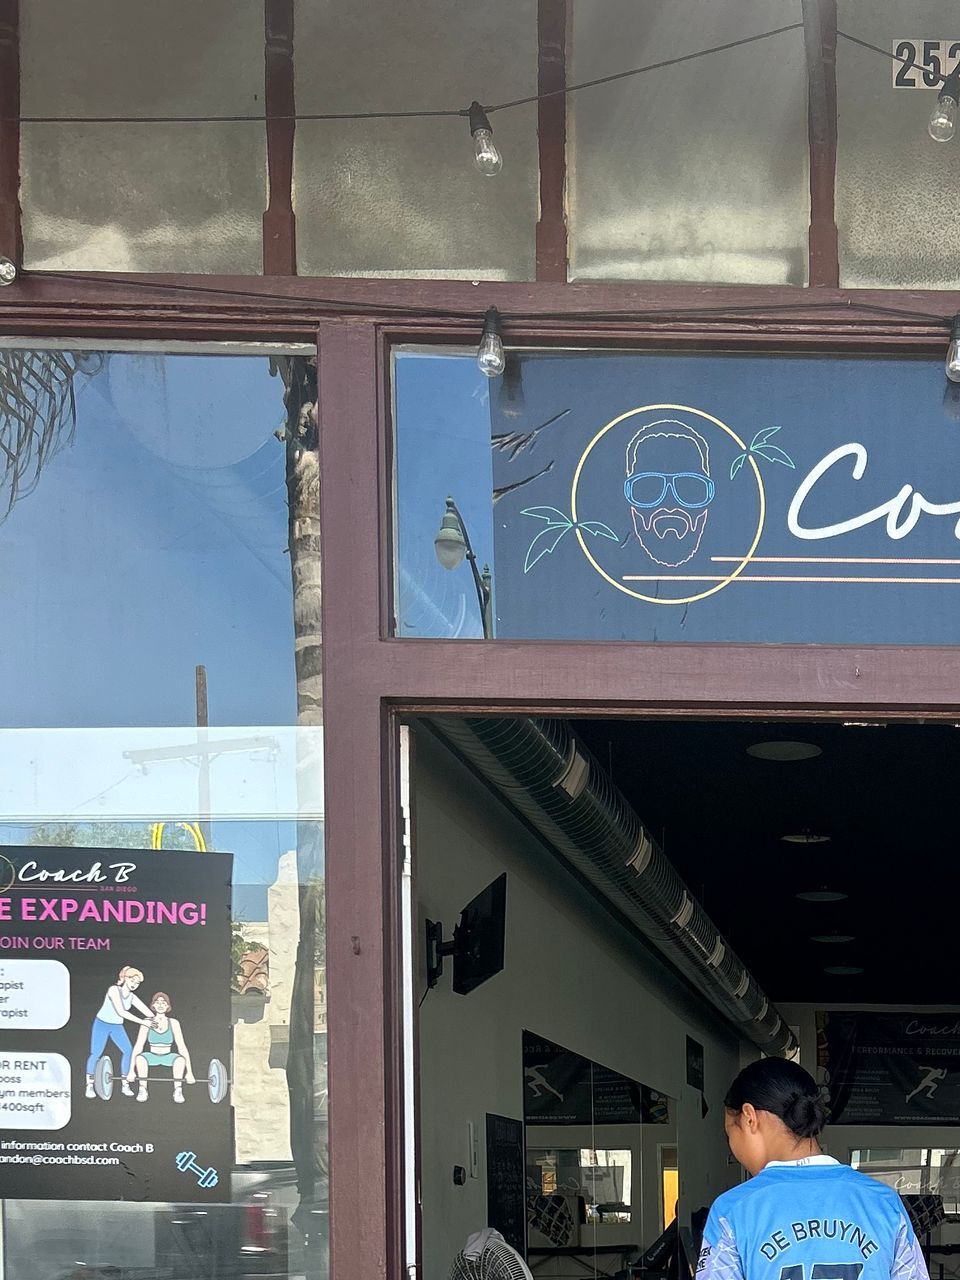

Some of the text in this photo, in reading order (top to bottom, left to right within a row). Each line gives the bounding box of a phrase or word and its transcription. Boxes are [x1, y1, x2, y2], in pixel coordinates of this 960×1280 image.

[18, 861, 137, 883] Coach B
[22, 898, 207, 926] EXPANDING!
[0, 936, 110, 951] OIN OUR TEAM
[0, 1060, 47, 1070] R RENT
[18, 1089, 69, 1098] members
[0, 1102, 44, 1114] 400sqft
[1, 1140, 154, 1152] information contact Coach B
[760, 1219, 879, 1261] DE BRUYNE
